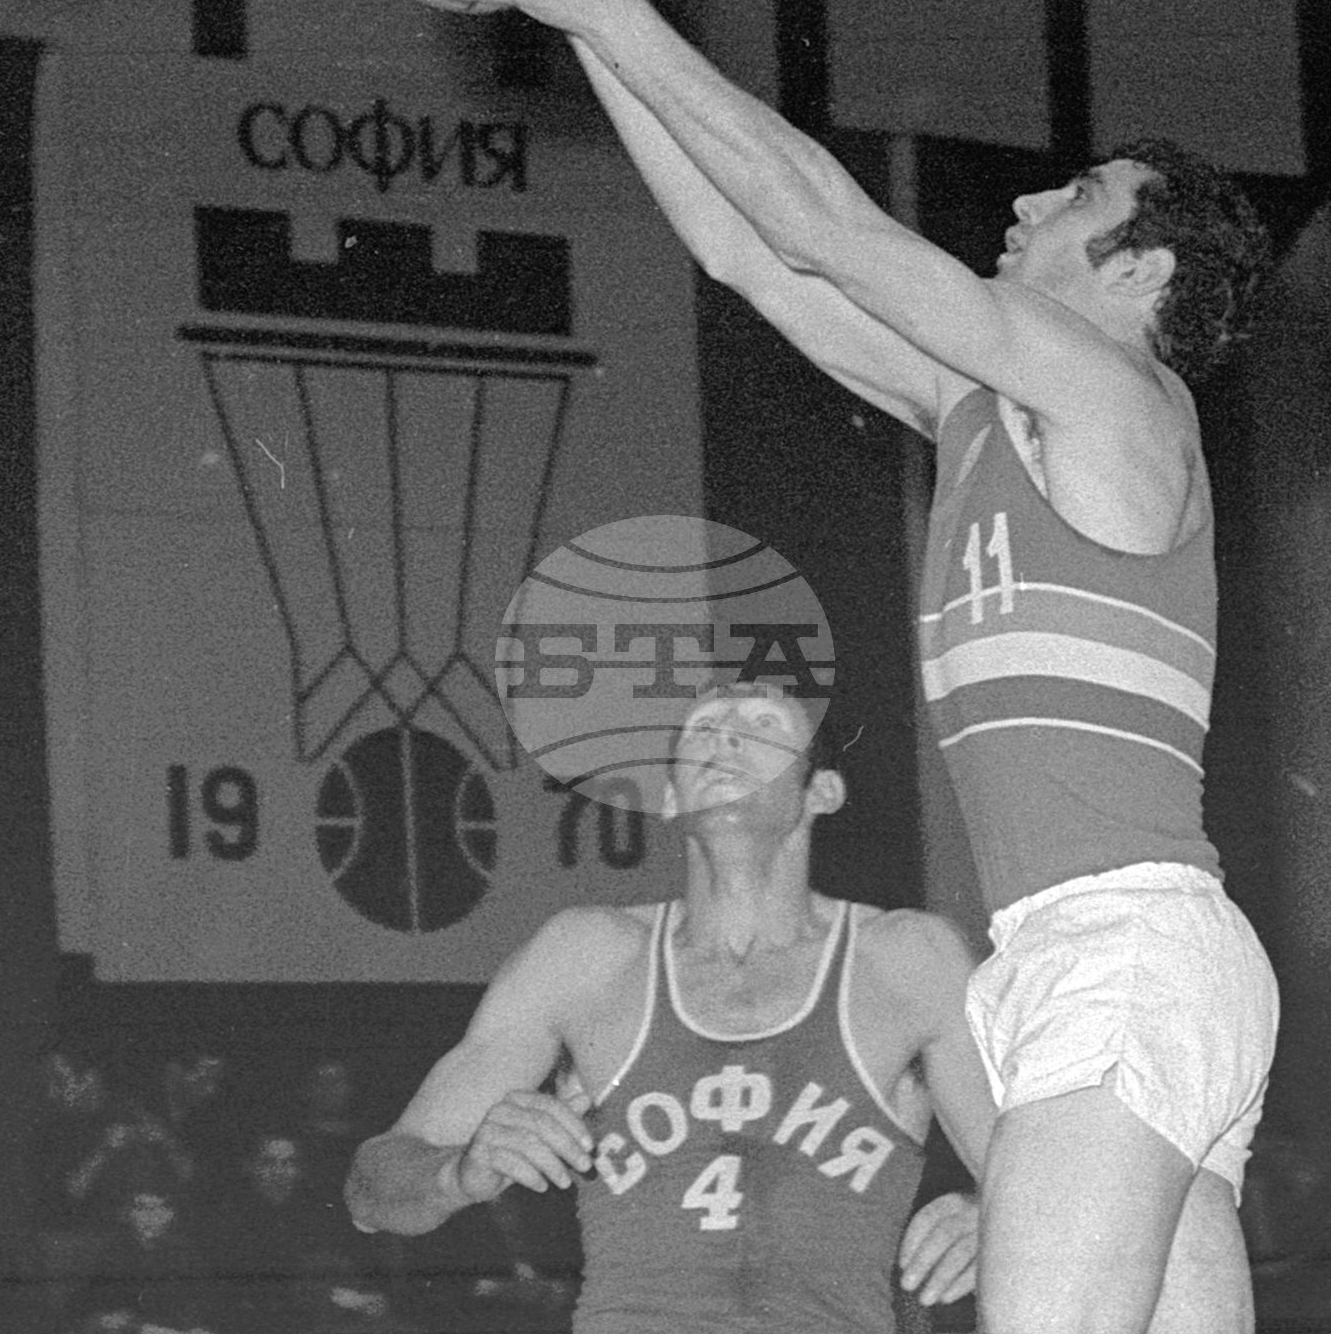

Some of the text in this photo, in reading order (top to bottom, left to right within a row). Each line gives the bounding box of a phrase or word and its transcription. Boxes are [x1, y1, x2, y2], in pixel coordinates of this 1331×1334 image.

[237, 99, 527, 193] СОФИЯ
[962, 512, 1014, 624] 11
[168, 764, 647, 869] 19 70
[594, 1065, 895, 1195] СОФИЯ
[681, 1154, 743, 1231] 4
